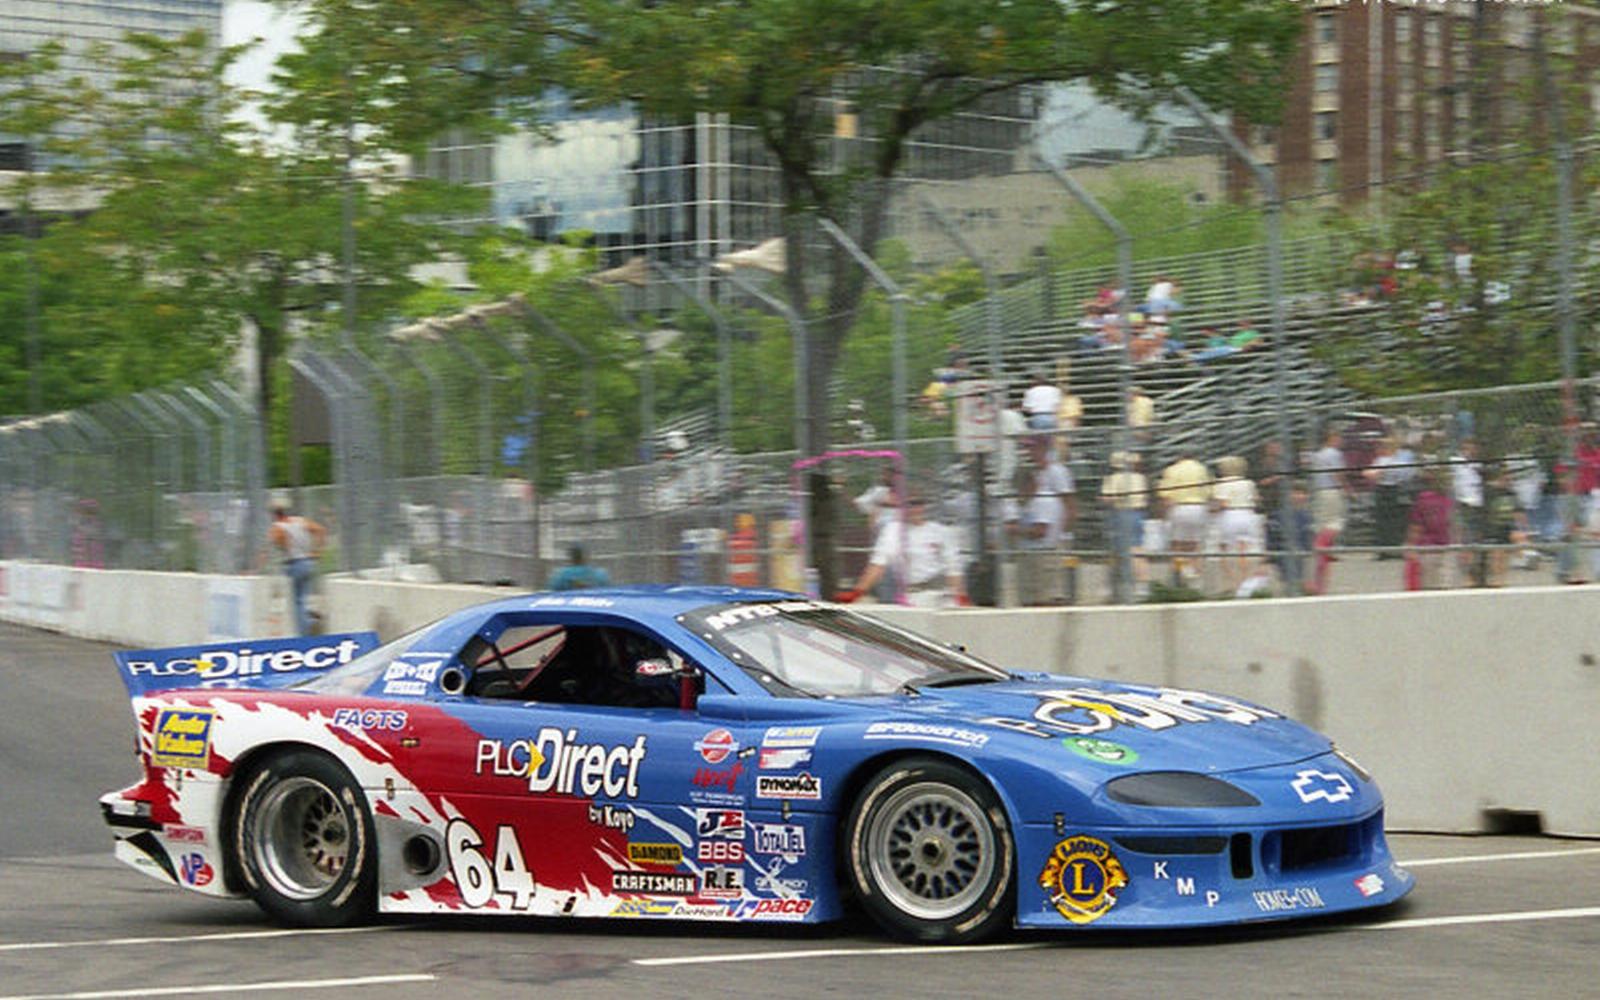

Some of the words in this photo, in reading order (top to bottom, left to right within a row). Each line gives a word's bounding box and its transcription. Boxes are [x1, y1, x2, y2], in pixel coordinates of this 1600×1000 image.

[127, 660, 198, 676] PLC
[200, 639, 359, 679] Direct
[333, 709, 408, 730] FACTS
[476, 739, 532, 776] PLC
[529, 728, 647, 798] Direct
[605, 806, 635, 833] Koyo
[446, 817, 536, 910] 64
[698, 841, 744, 861] BBS
[612, 872, 695, 892] CRAFTSMAN
[1072, 863, 1095, 895] L
[1154, 861, 1169, 880] K
[1176, 877, 1196, 896] M
[1206, 891, 1220, 908] P
[752, 899, 812, 917] pace
